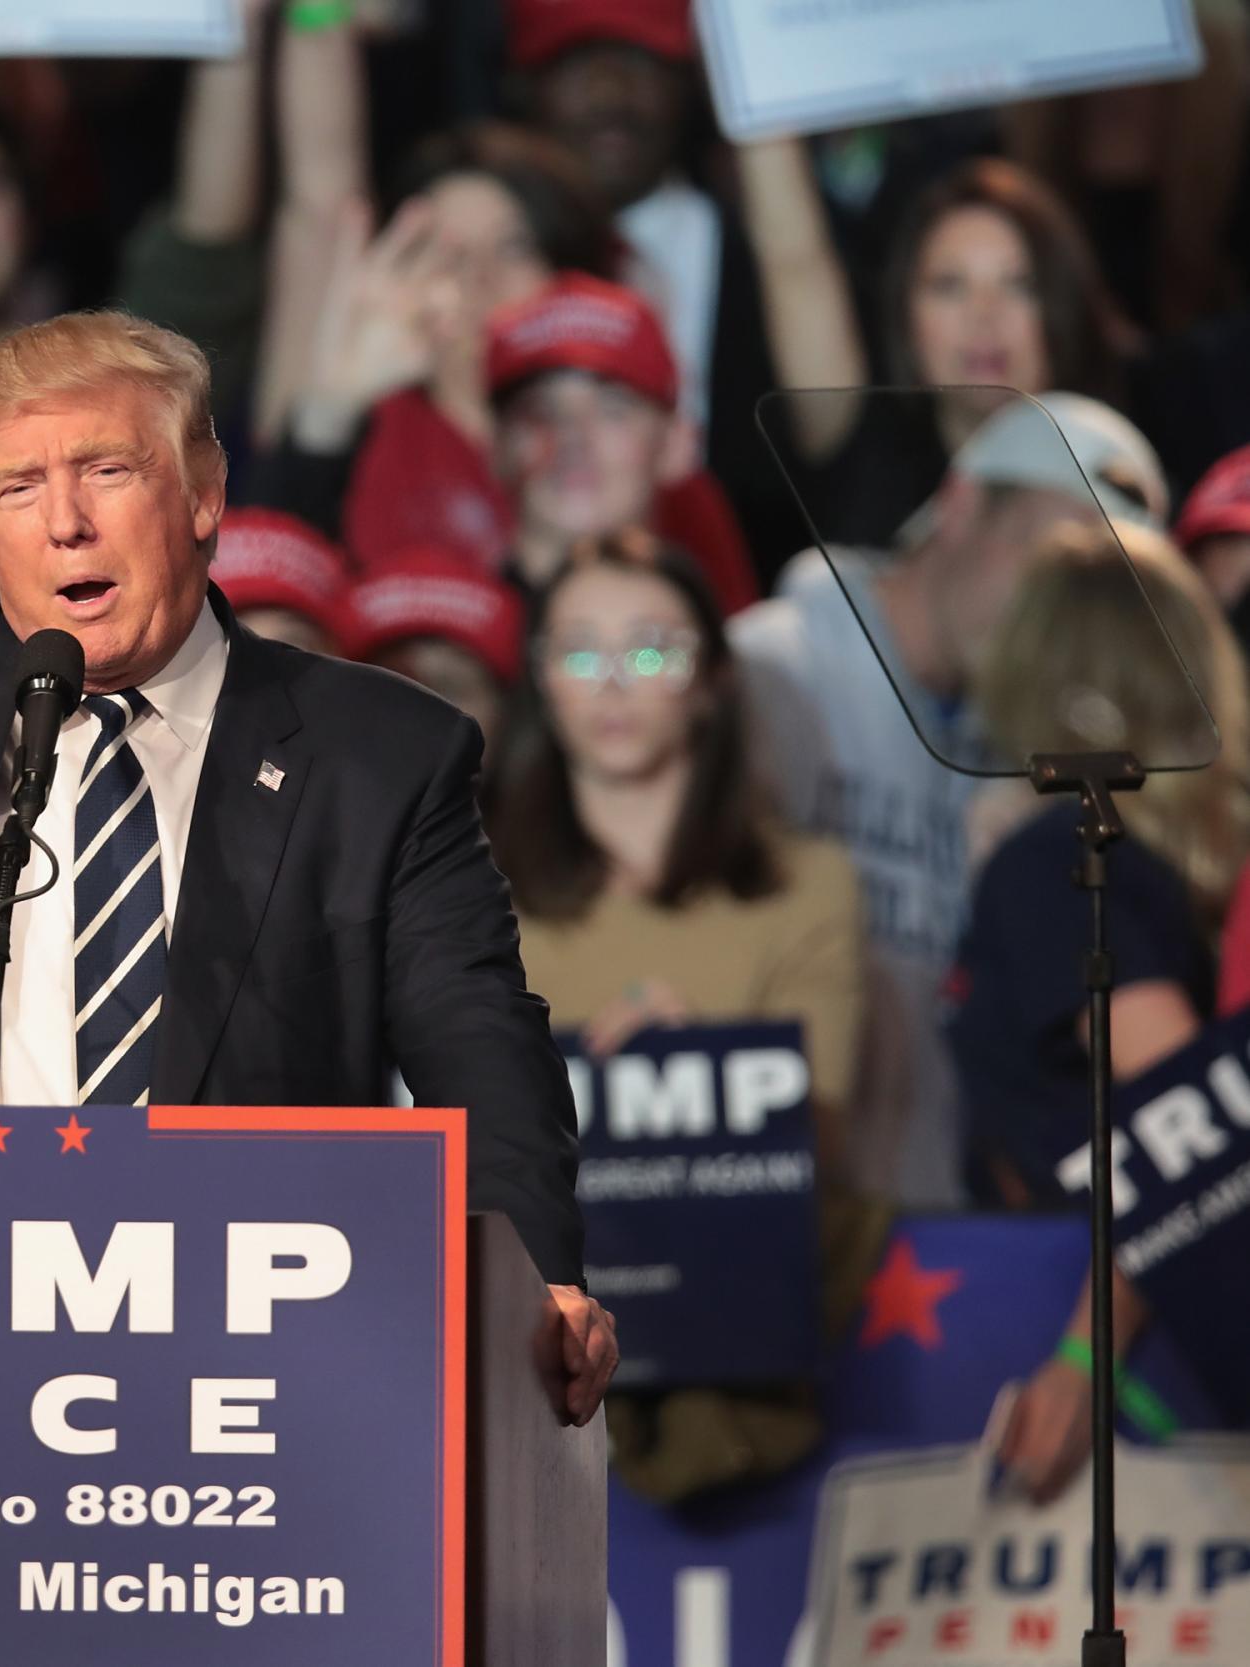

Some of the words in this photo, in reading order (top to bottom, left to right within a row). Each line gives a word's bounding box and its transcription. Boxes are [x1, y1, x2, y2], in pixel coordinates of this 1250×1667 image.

[65, 1484, 277, 1526] 88022
[19, 1561, 345, 1626] Michigan
[865, 1608, 1213, 1658] PENE
